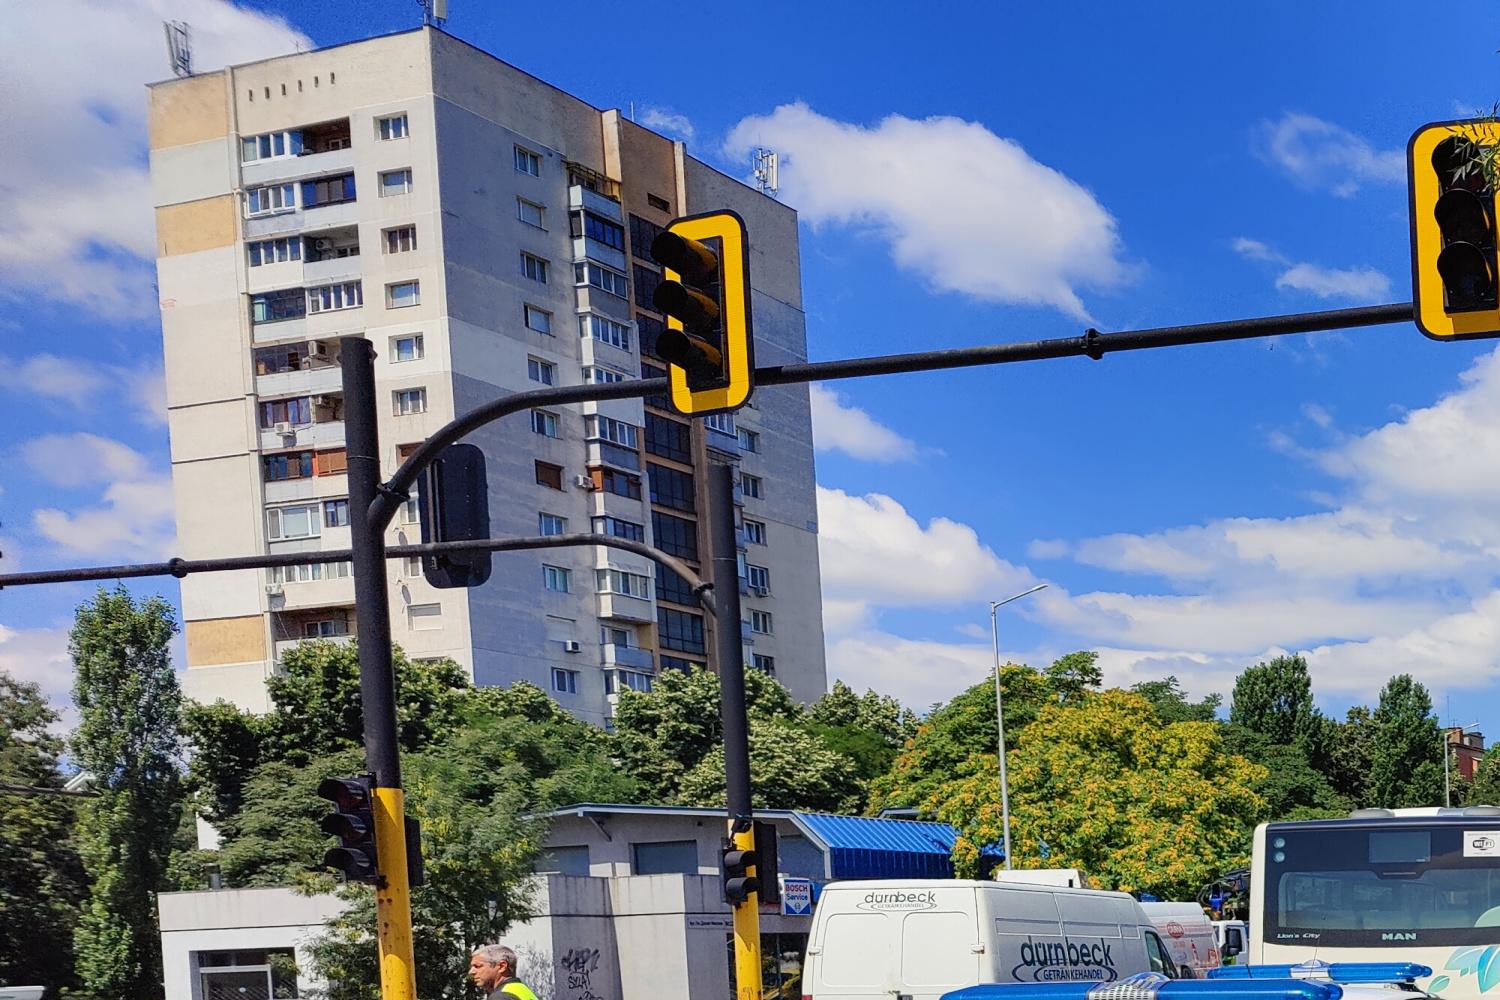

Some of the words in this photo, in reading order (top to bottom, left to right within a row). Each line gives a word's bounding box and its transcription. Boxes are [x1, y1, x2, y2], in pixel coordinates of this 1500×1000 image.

[785, 884, 808, 892] BOSCH
[785, 892, 808, 900] Service
[1302, 932, 1321, 940] City
